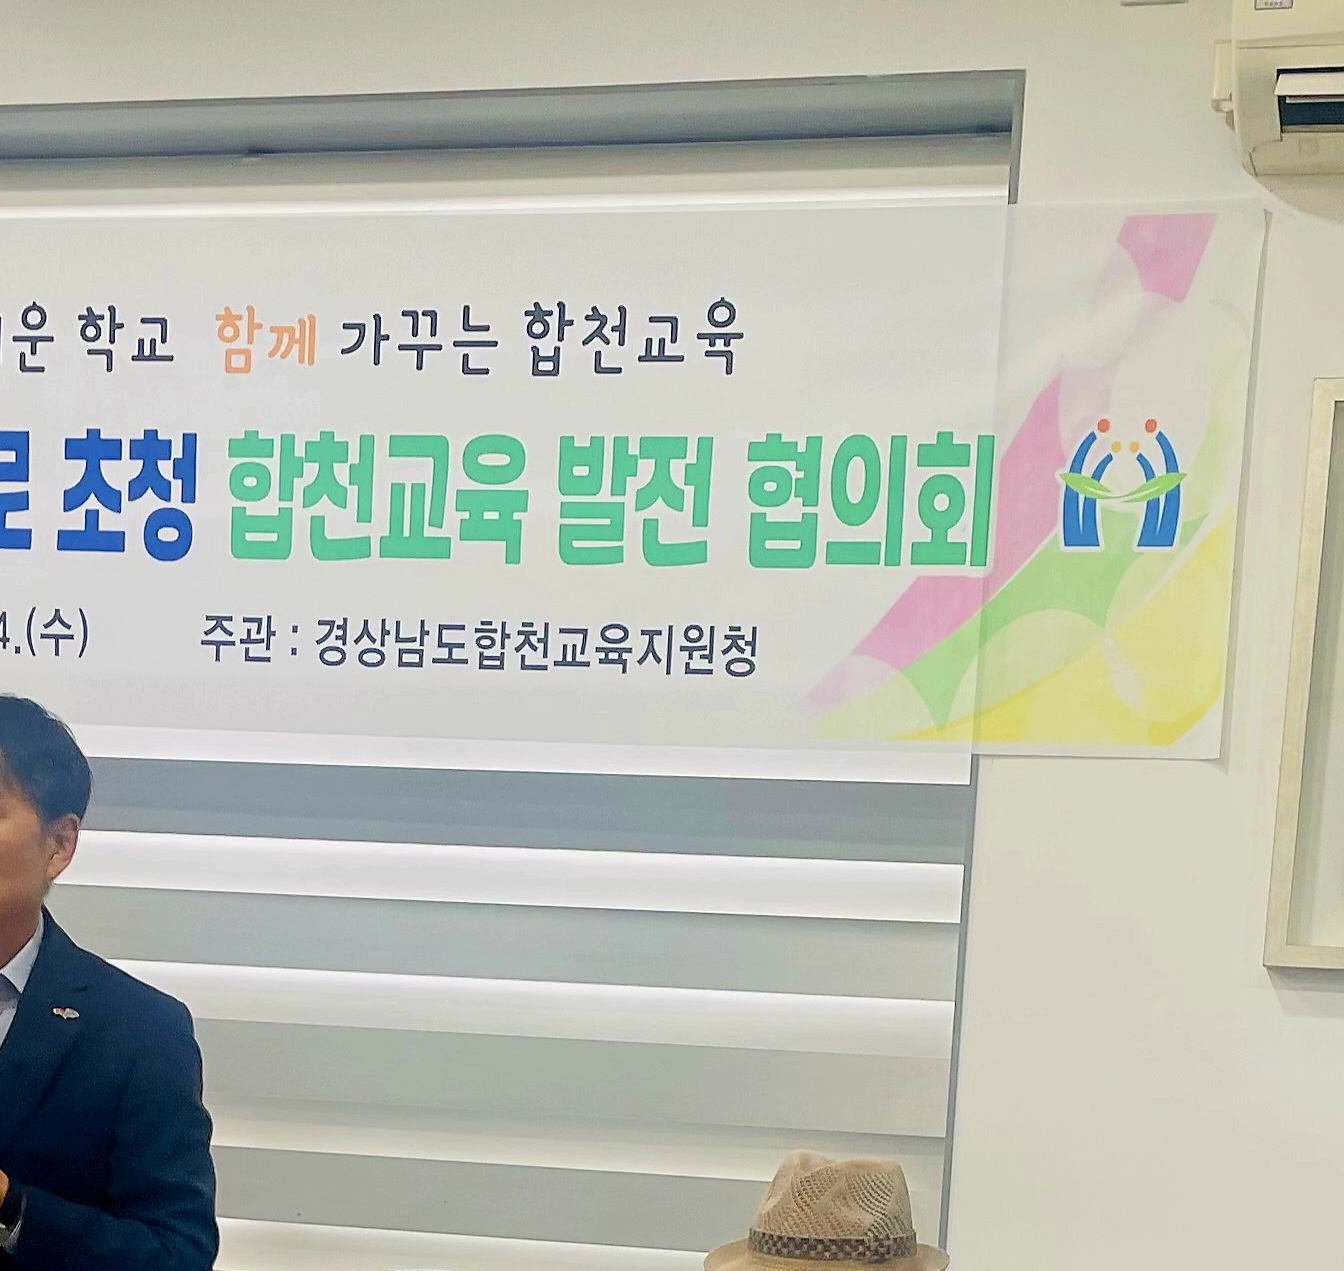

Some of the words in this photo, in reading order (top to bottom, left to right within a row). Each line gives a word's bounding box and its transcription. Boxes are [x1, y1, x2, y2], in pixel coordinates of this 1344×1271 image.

[78, 305, 174, 373] 학교
[214, 304, 318, 376] 함께
[340, 305, 499, 377] 가꾸는
[524, 297, 745, 378] 합천교육
[56, 427, 198, 562] 초청
[228, 429, 529, 565] 합천교육
[557, 434, 714, 567] 발전
[747, 430, 996, 570] 협의회
[200, 613, 277, 664] 주관
[314, 614, 760, 678] 경상남도합천교육지원청
